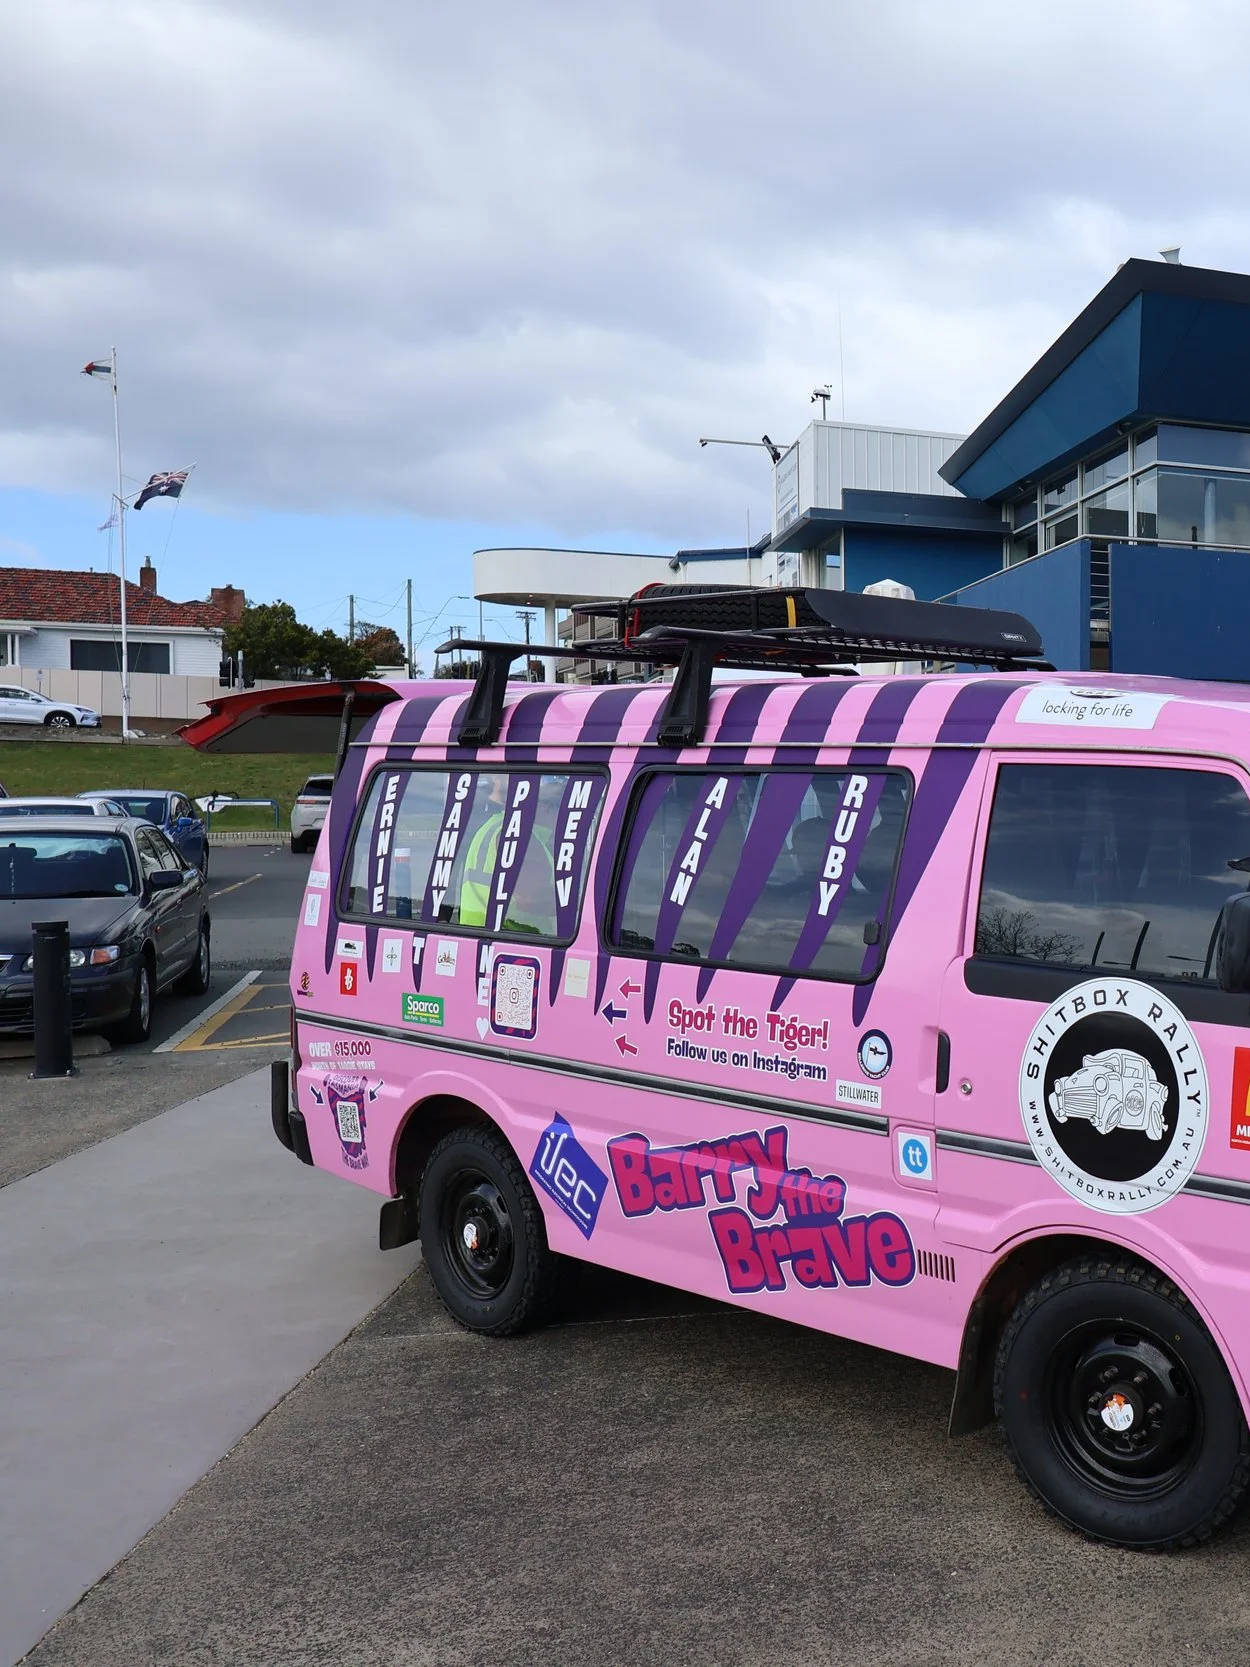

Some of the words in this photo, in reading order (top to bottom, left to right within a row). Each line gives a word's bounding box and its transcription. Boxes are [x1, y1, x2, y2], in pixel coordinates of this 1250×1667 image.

[1042, 700, 1087, 720] locking
[1090, 702, 1110, 716] for
[1112, 703, 1133, 717] life
[372, 774, 400, 914] ERNIE
[431, 773, 472, 917] SAMMY
[556, 780, 593, 908] MERV
[669, 776, 729, 906] ALAN
[817, 774, 869, 917] RUBY
[407, 995, 440, 1015] Sparco
[669, 999, 715, 1035] Spot
[722, 1007, 758, 1039] the
[766, 1012, 829, 1052] Tiger!
[1026, 988, 1130, 1080] SHITBOX
[1146, 1002, 1201, 1105] RALLY
[309, 1041, 332, 1057] OVER
[334, 1040, 372, 1058] $15,000
[667, 1038, 708, 1061] Follow
[711, 1049, 728, 1064] us
[732, 1052, 749, 1067] on
[753, 1051, 828, 1080] Instagram
[838, 1085, 879, 1103] STILLWATER
[608, 1125, 788, 1219] Barry
[785, 1168, 846, 1218] the
[908, 1145, 923, 1168] tt
[709, 1208, 915, 1293] Brave
